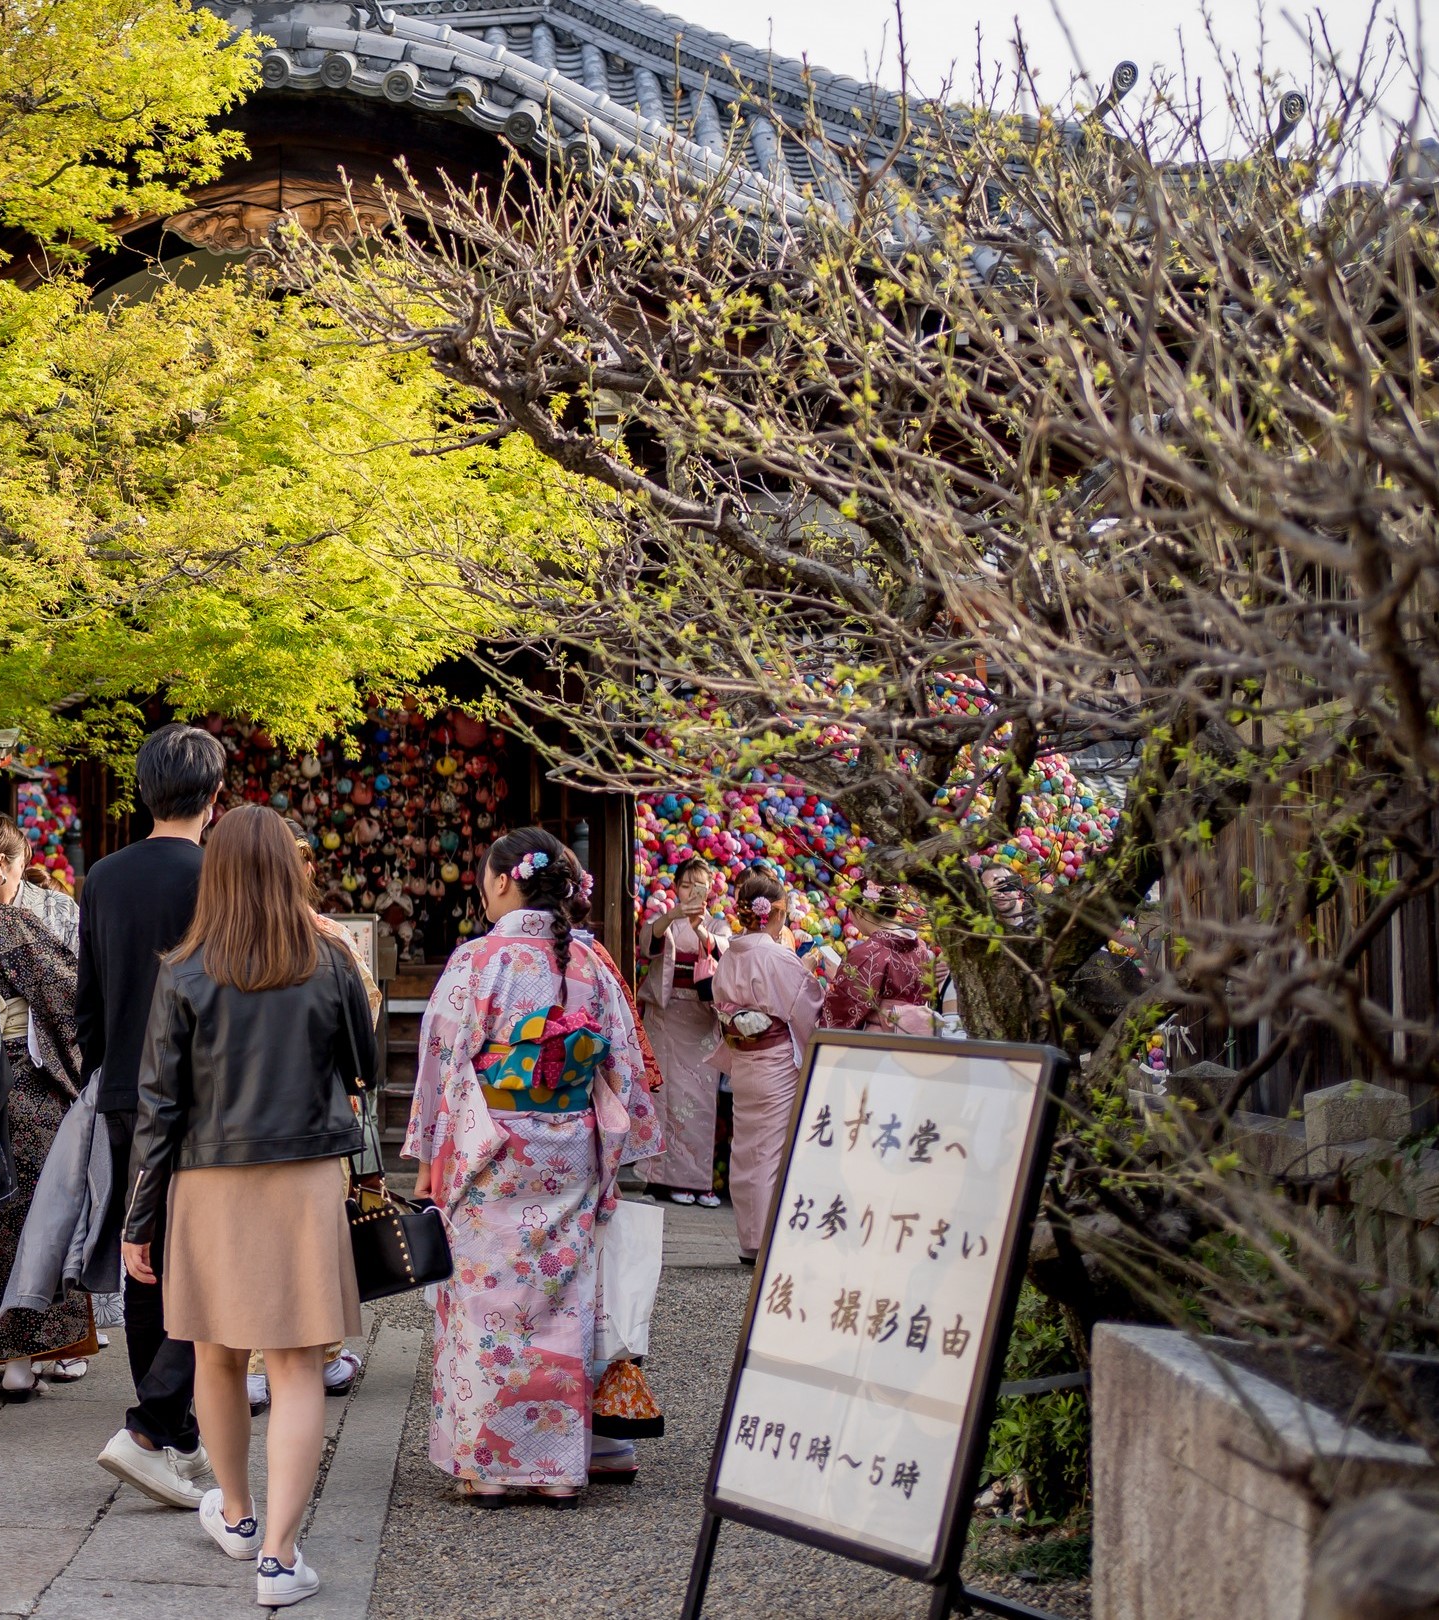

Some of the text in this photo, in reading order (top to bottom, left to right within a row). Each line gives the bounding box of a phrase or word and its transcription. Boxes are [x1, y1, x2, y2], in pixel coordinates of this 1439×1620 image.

[806, 1086, 968, 1164] 先ず本堂へ
[788, 1193, 989, 1260] お参り下さい
